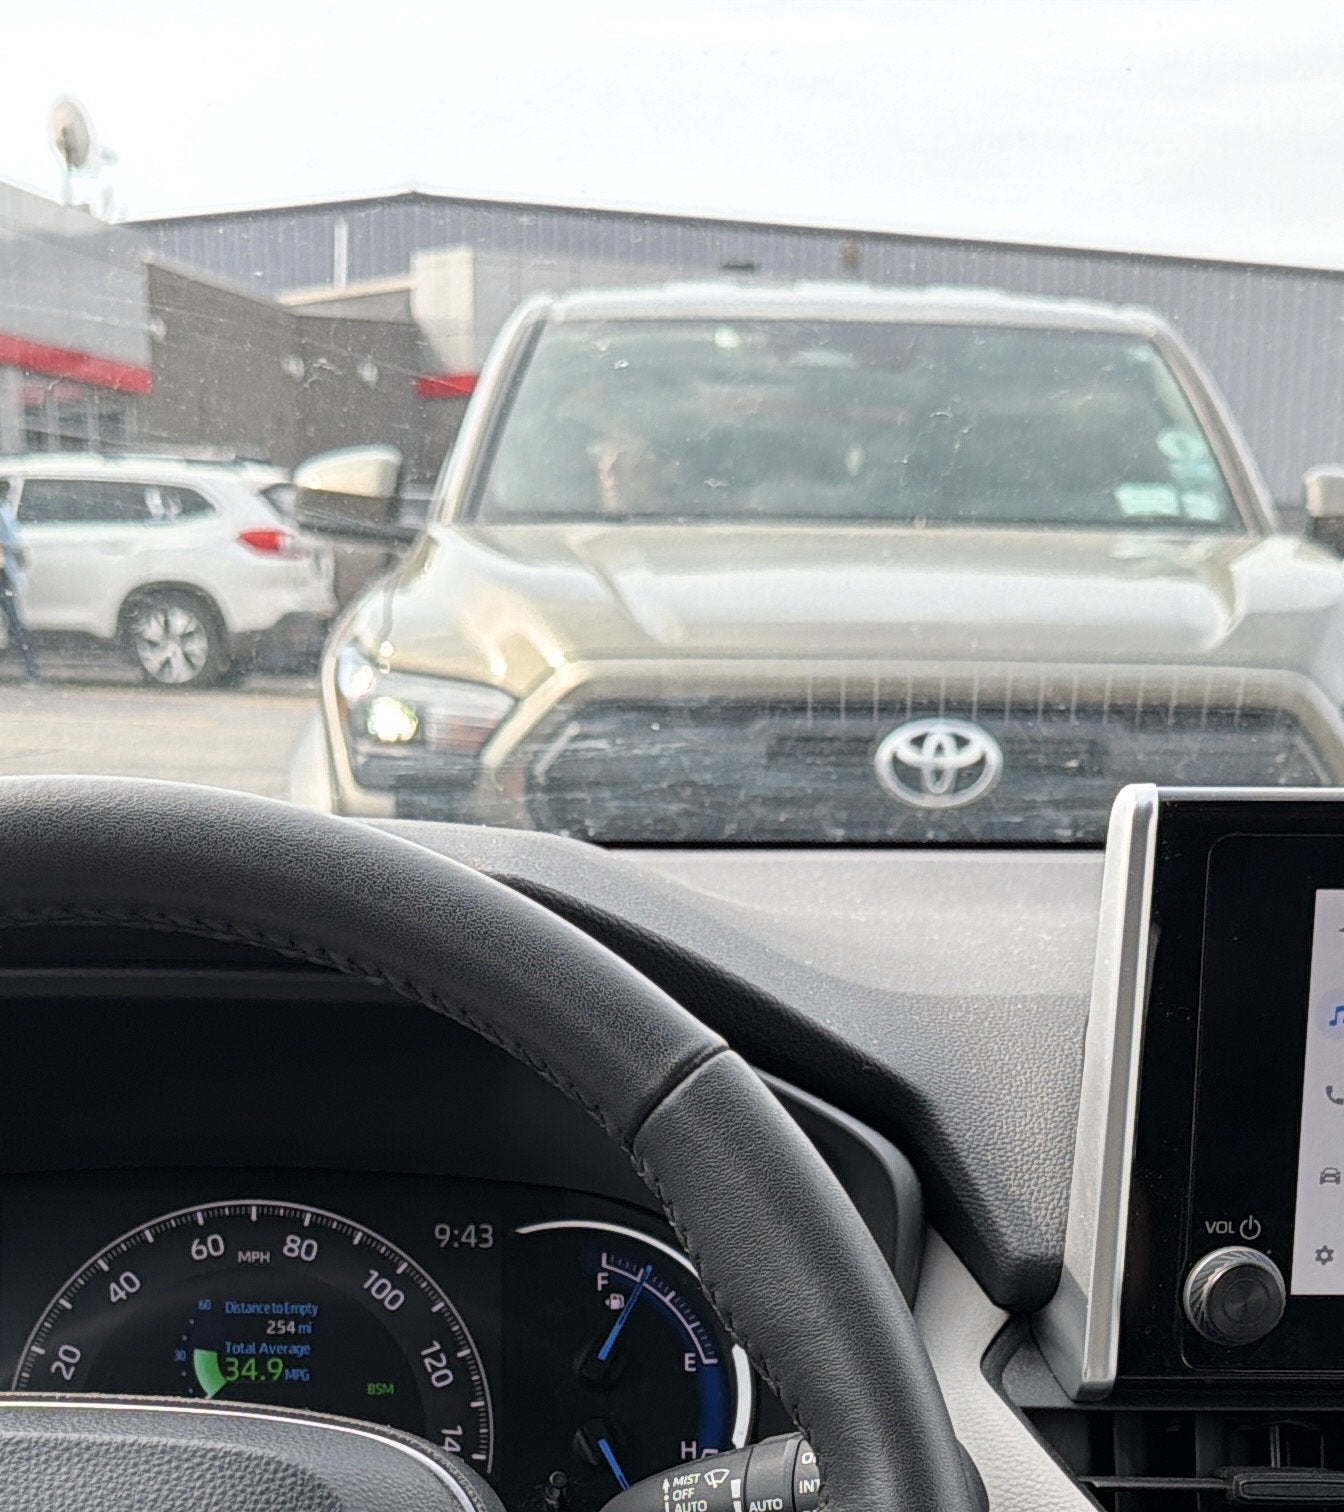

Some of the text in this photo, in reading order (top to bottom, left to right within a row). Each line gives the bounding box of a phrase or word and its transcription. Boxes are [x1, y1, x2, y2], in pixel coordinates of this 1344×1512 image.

[434, 1223, 494, 1249] 9:43
[1205, 1220, 1235, 1234] VOL
[190, 1233, 225, 1262] 60
[237, 1250, 271, 1264] MPH
[282, 1234, 318, 1262] 80
[108, 1271, 142, 1304] 40
[362, 1269, 405, 1311] 100
[596, 1273, 609, 1292] F
[225, 1302, 318, 1317] Distance to Empty
[266, 1320, 312, 1335] 254 mi
[225, 1342, 311, 1356] Total Average
[51, 1343, 81, 1380] 20
[225, 1357, 310, 1382] 34.9 MPG
[420, 1341, 453, 1388] 120
[684, 1352, 697, 1372] E
[367, 1383, 394, 1395] BSM
[681, 1441, 697, 1460] H
[673, 1473, 702, 1487] MIST
[672, 1488, 696, 1501] OFF
